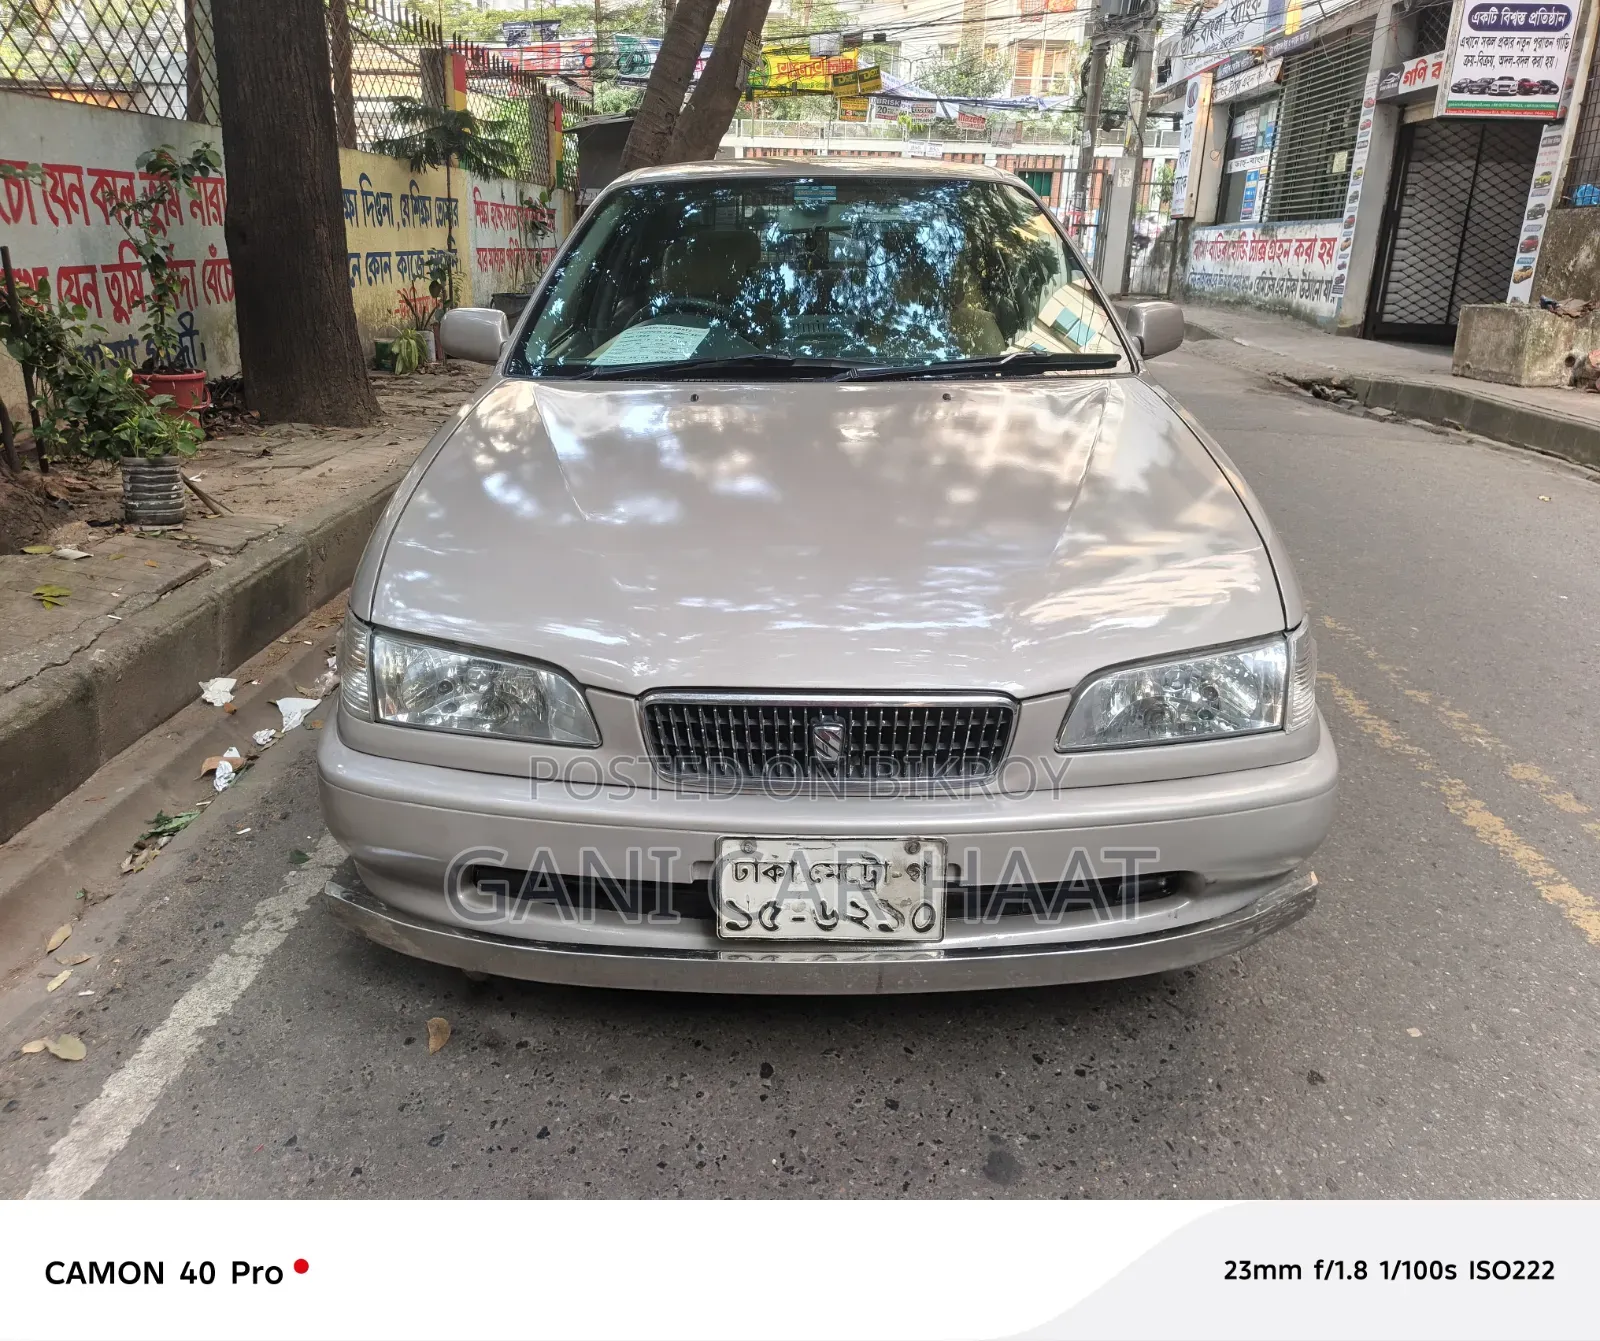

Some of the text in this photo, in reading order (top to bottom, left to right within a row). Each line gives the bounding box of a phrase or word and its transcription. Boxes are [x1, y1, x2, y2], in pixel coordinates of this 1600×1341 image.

[1471, 6, 1568, 27] একটি বিশ্বস্ত প্রতিষ্ঠান
[1460, 33, 1571, 53] এখানে সকল প্রকার নতুন পুরাতন গাড়ি
[1402, 58, 1428, 86] গণি
[1499, 55, 1530, 69] অদল-বদল
[1531, 56, 1544, 68] করা
[41, 162, 91, 228] যেন
[409, 179, 433, 229] শিক্ষা
[1294, 233, 1318, 264] করা
[1318, 236, 1338, 271] হয়
[101, 239, 146, 326] তুমি
[366, 251, 392, 287] কোন
[730, 856, 798, 884] ঢাকা
